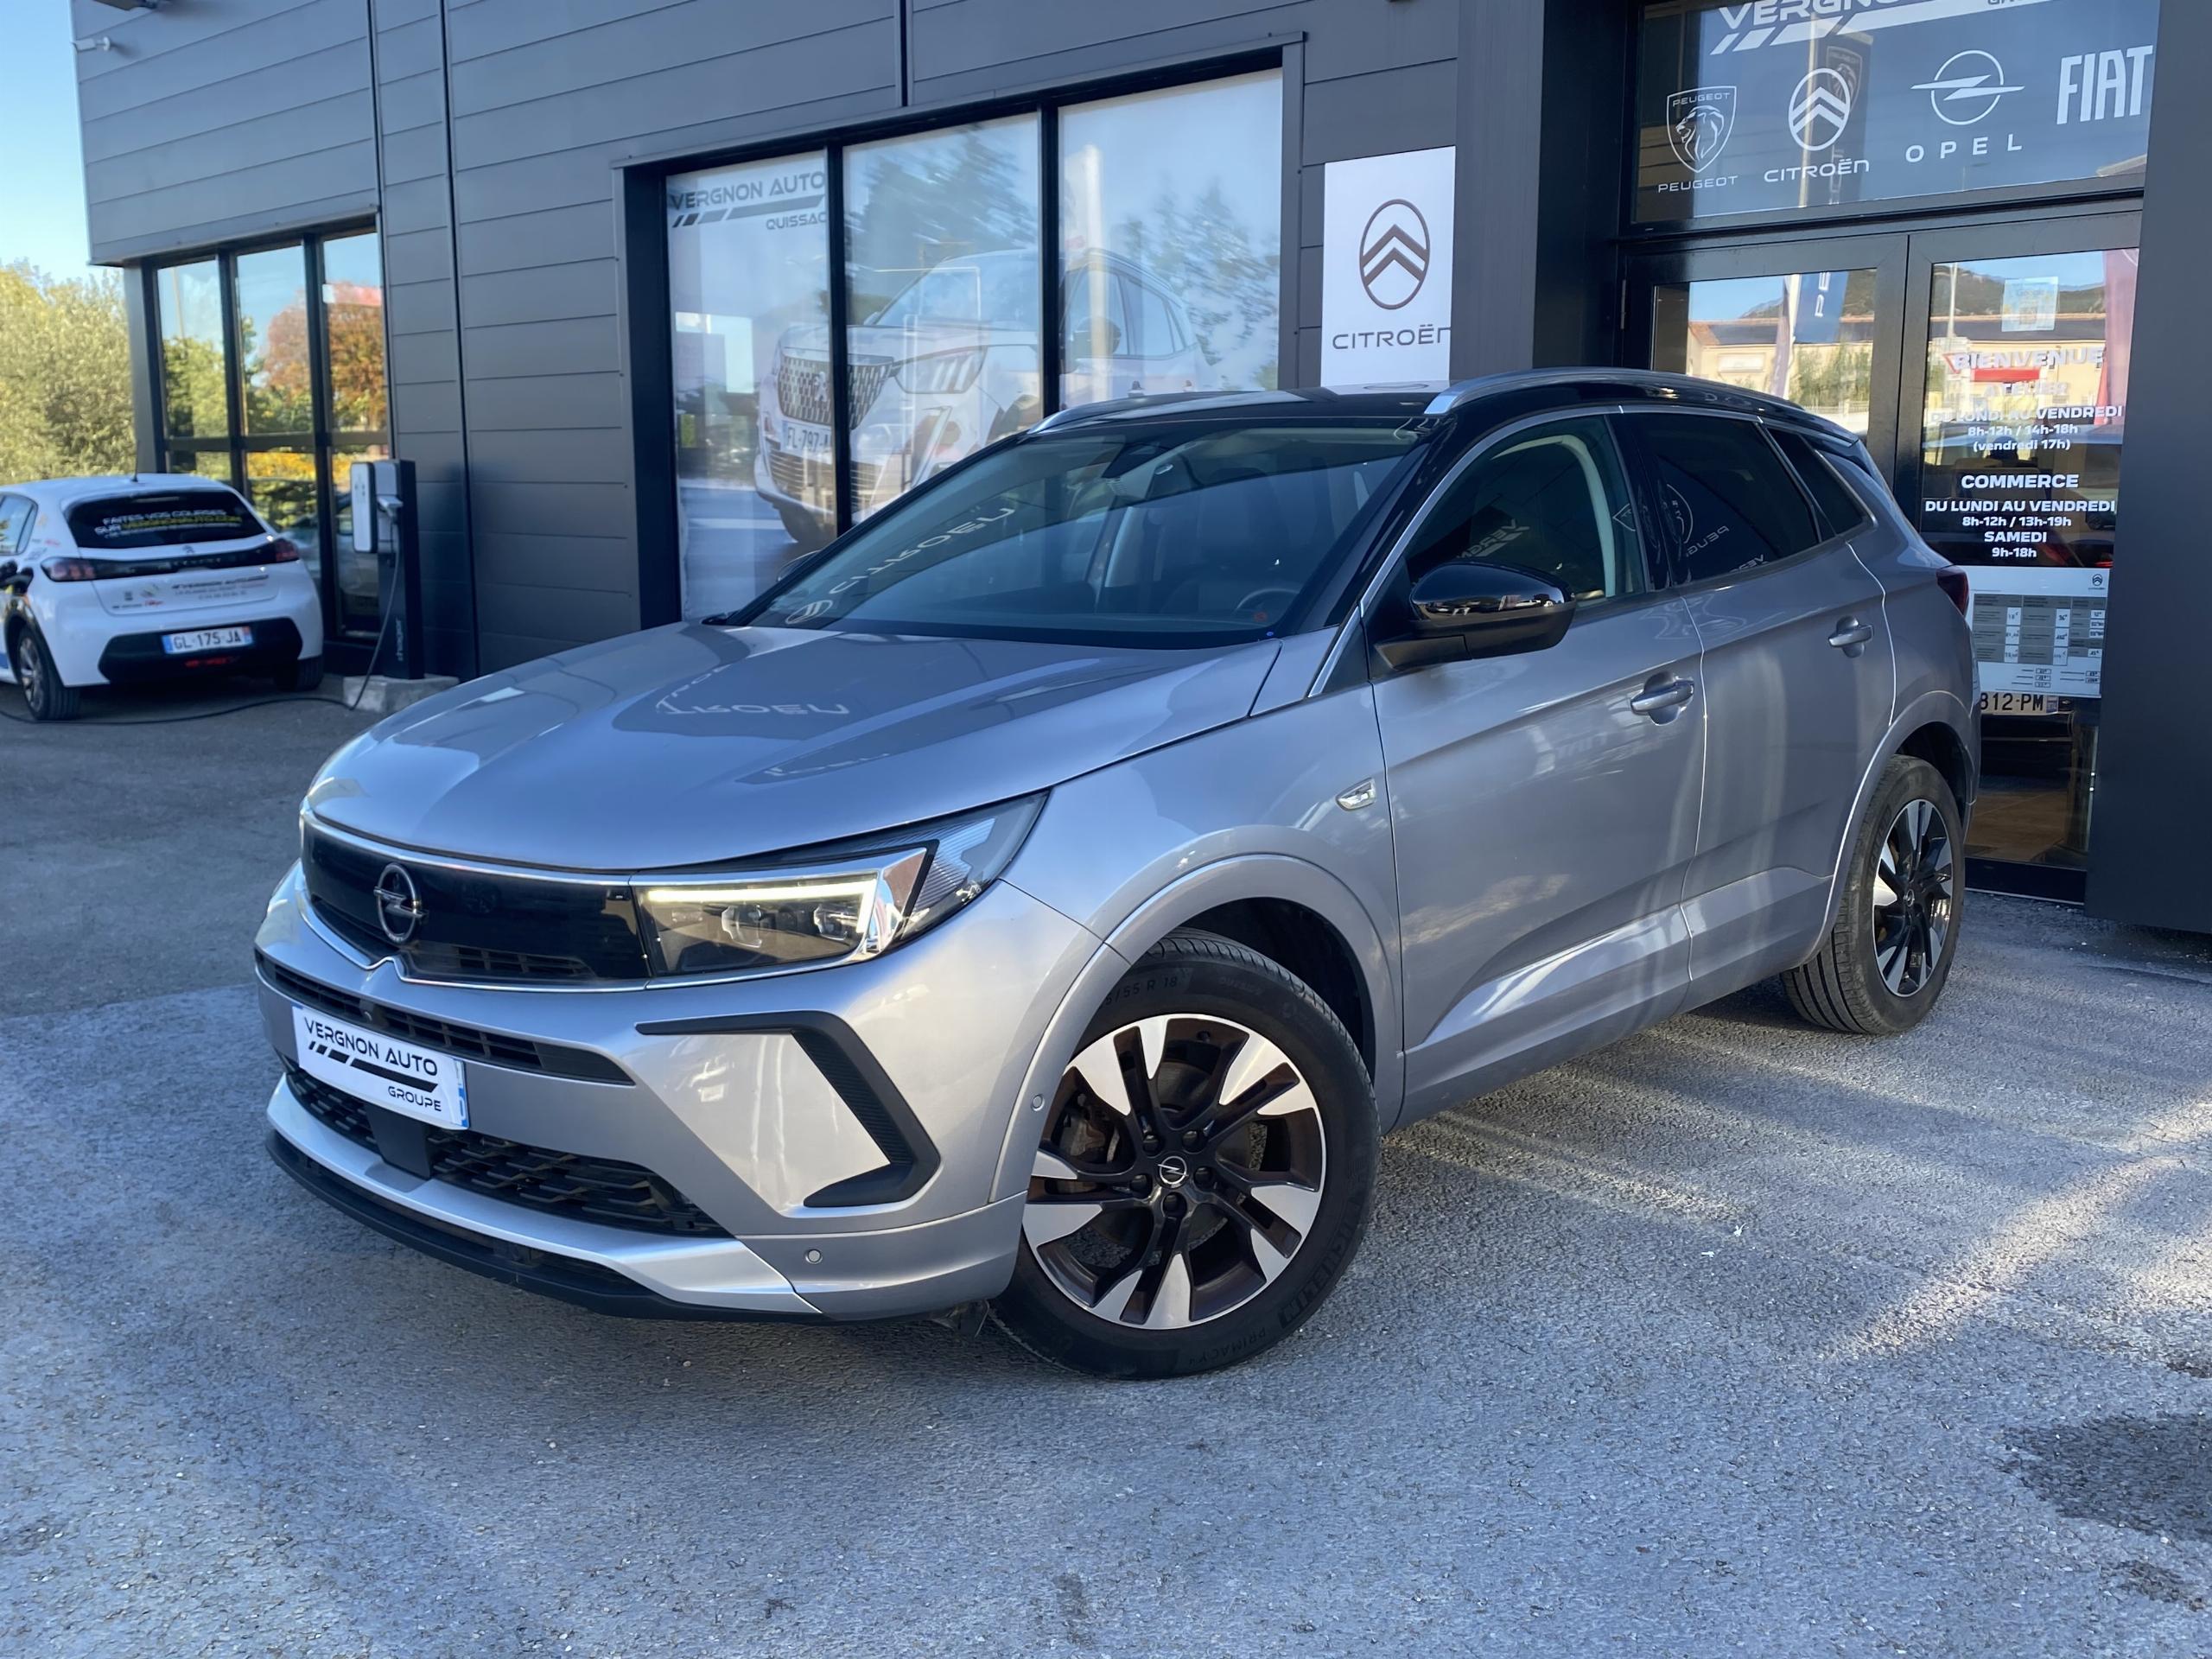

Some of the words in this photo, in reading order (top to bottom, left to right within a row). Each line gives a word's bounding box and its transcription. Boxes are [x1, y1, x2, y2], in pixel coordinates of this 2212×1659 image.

[2056, 45, 2153, 125] FIAT
[1672, 92, 1731, 107] PEUGEOT
[1904, 133, 2023, 163] OPEL
[1764, 158, 1869, 183] CITROËN
[671, 181, 764, 211] VERGNON
[769, 171, 825, 197] AUTO
[1657, 175, 1738, 194] PEUGEOT
[766, 212, 827, 231] QUISSAC
[1953, 346, 2105, 369] BIENVENUE
[2036, 405, 2122, 420] VENDREDI
[1974, 440, 2037, 453] (vendredi
[2041, 439, 2071, 451] 17h)
[1961, 474, 2079, 489] COMMERCE
[1925, 500, 1947, 512] DU
[1951, 500, 1999, 512] LUNDI
[2002, 500, 2025, 512] AU
[2030, 500, 2115, 512] VENDREDI
[1961, 517, 2006, 526] 8h-12h
[2018, 517, 2072, 527] 13h-19h
[1984, 531, 2047, 543] SAMEDI
[1992, 547, 2037, 557] 9h-18h
[304, 1017, 380, 1058] VERGNON
[385, 1048, 438, 1077] AUTO
[388, 1085, 442, 1112] GROUPE
